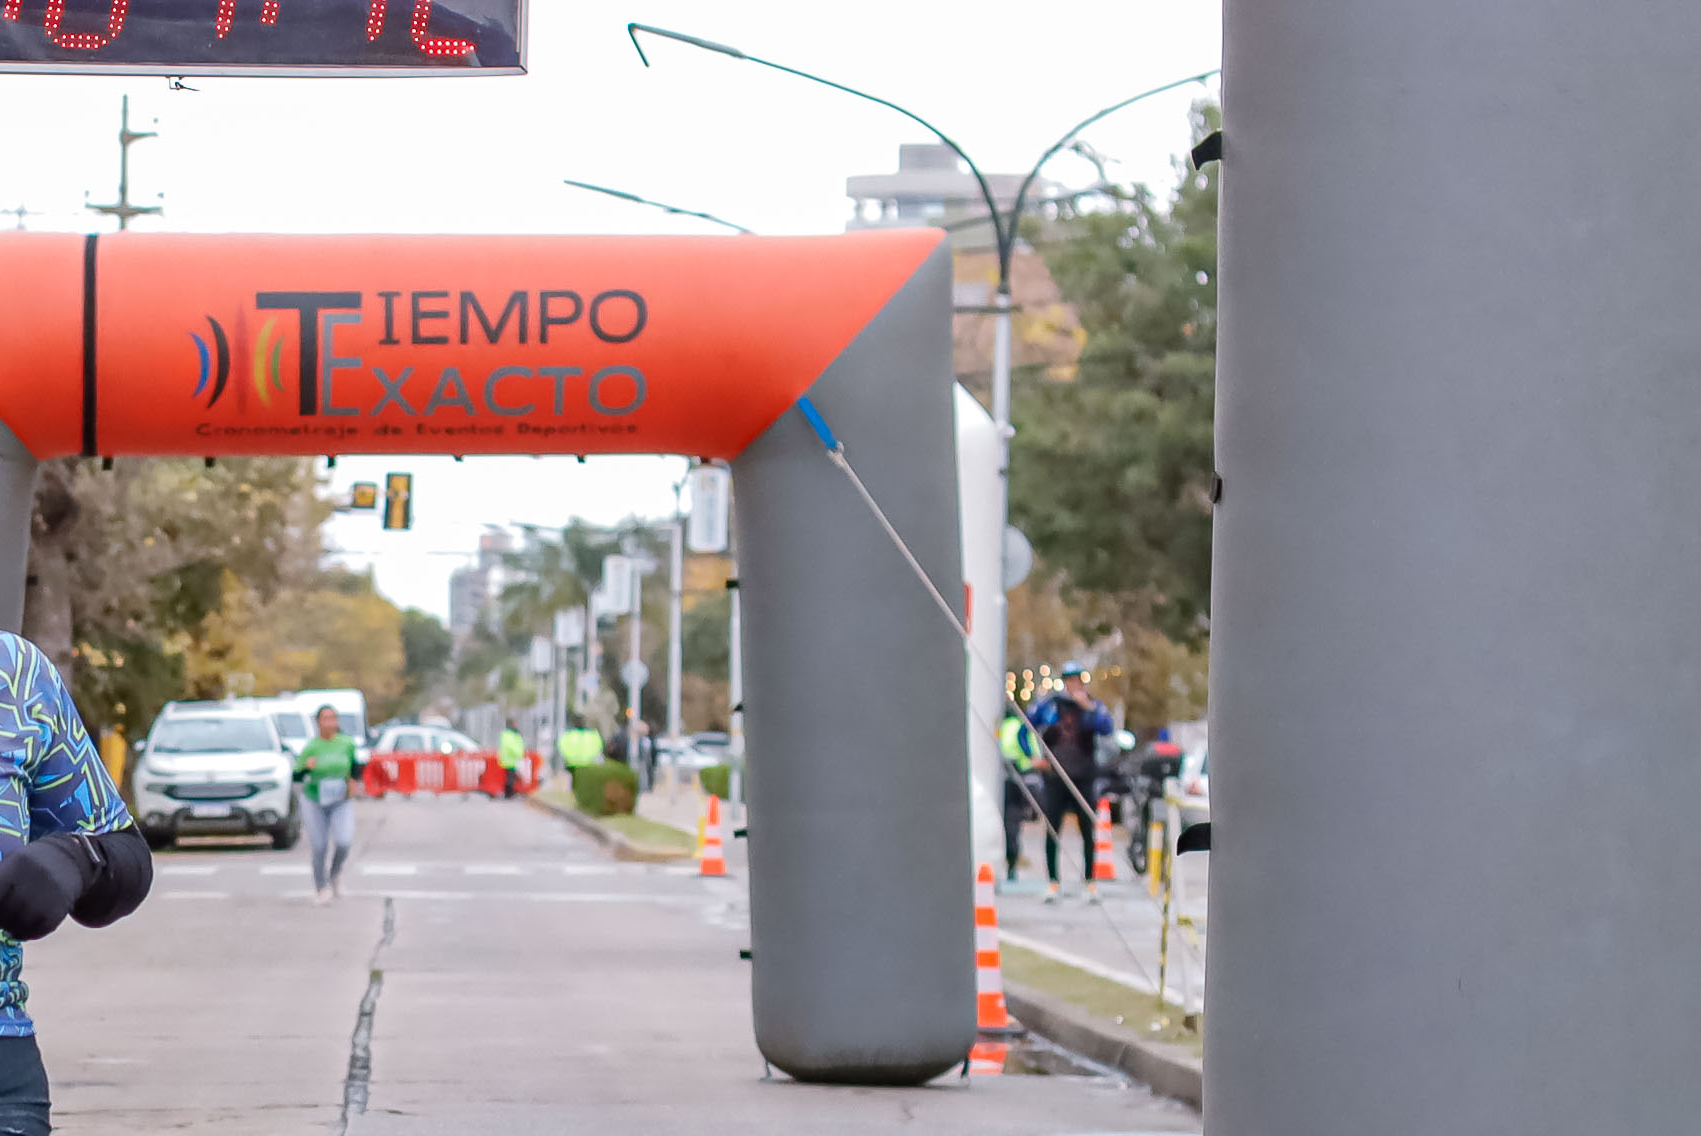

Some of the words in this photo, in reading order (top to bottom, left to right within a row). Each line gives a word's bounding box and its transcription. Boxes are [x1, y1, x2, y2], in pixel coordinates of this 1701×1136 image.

[256, 289, 648, 416] TIEMPO
[322, 313, 648, 417] EXACTO
[196, 422, 359, 439] Cronometraje
[374, 422, 403, 436] de
[416, 422, 504, 436] Eventos
[517, 421, 638, 438] Deportivos
